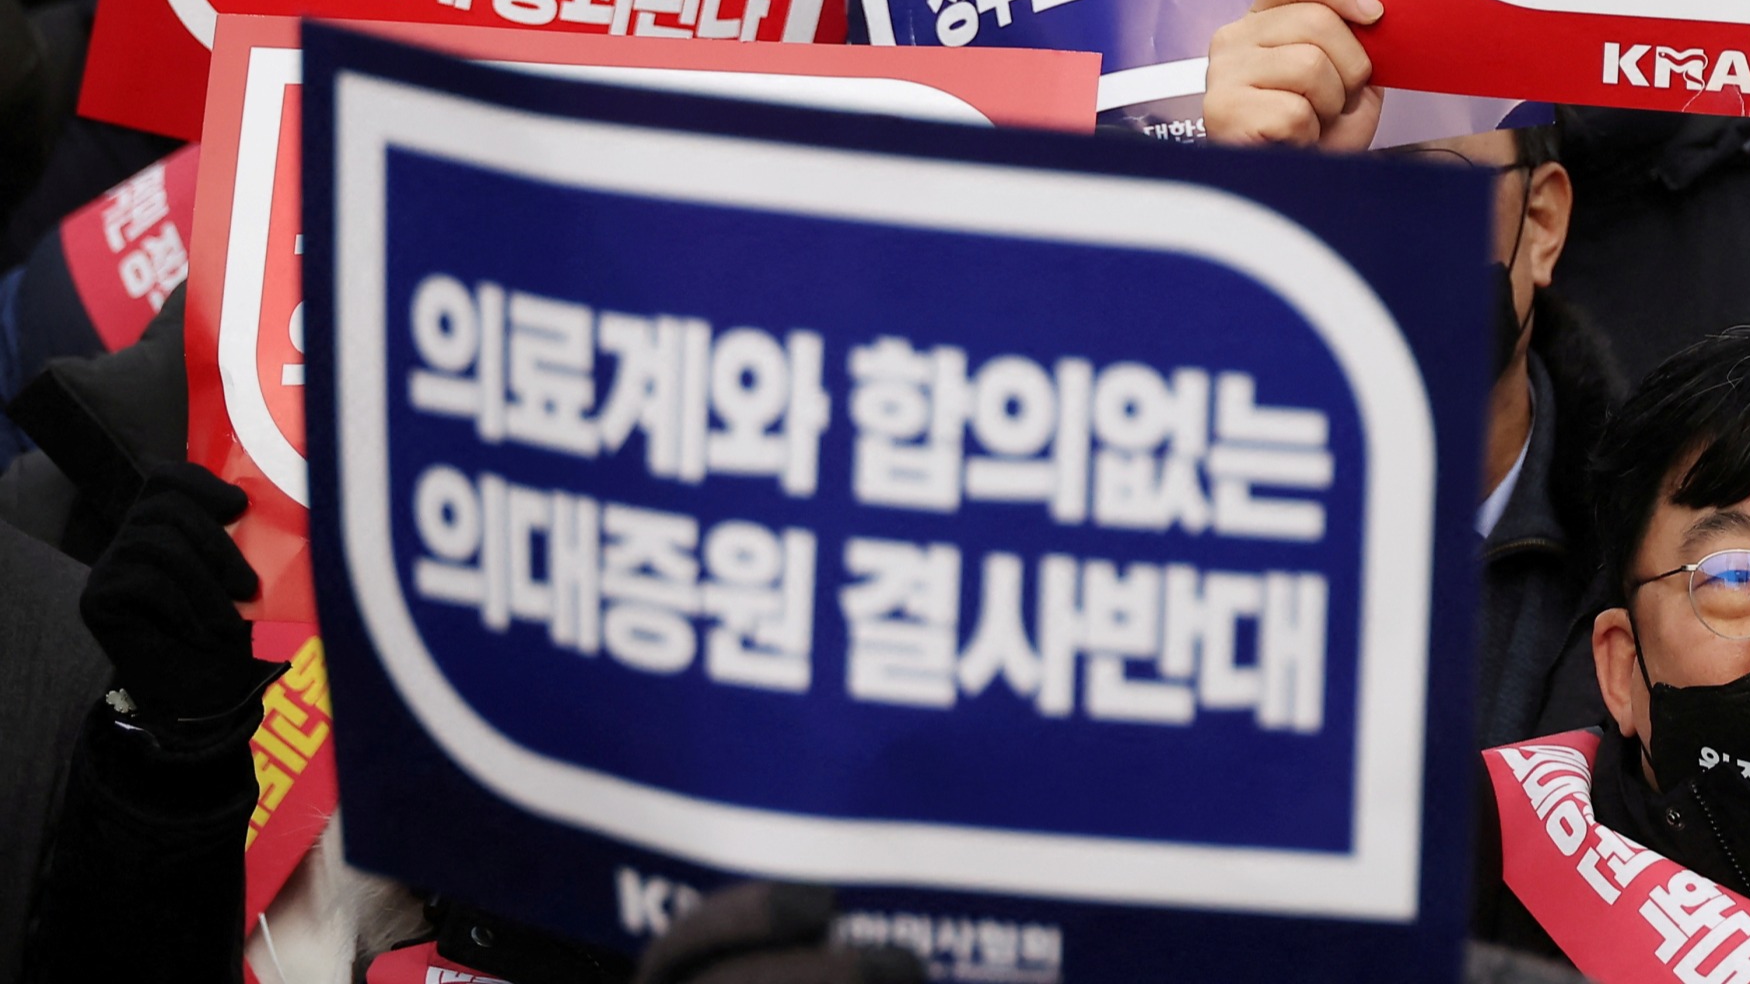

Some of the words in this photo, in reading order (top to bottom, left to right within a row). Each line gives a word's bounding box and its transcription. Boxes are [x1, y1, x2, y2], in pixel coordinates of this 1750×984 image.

[409, 273, 829, 498] 의료계와
[846, 335, 1335, 541] 합의없는
[411, 464, 819, 694] 의대증원
[837, 534, 1328, 733] 결사반대
